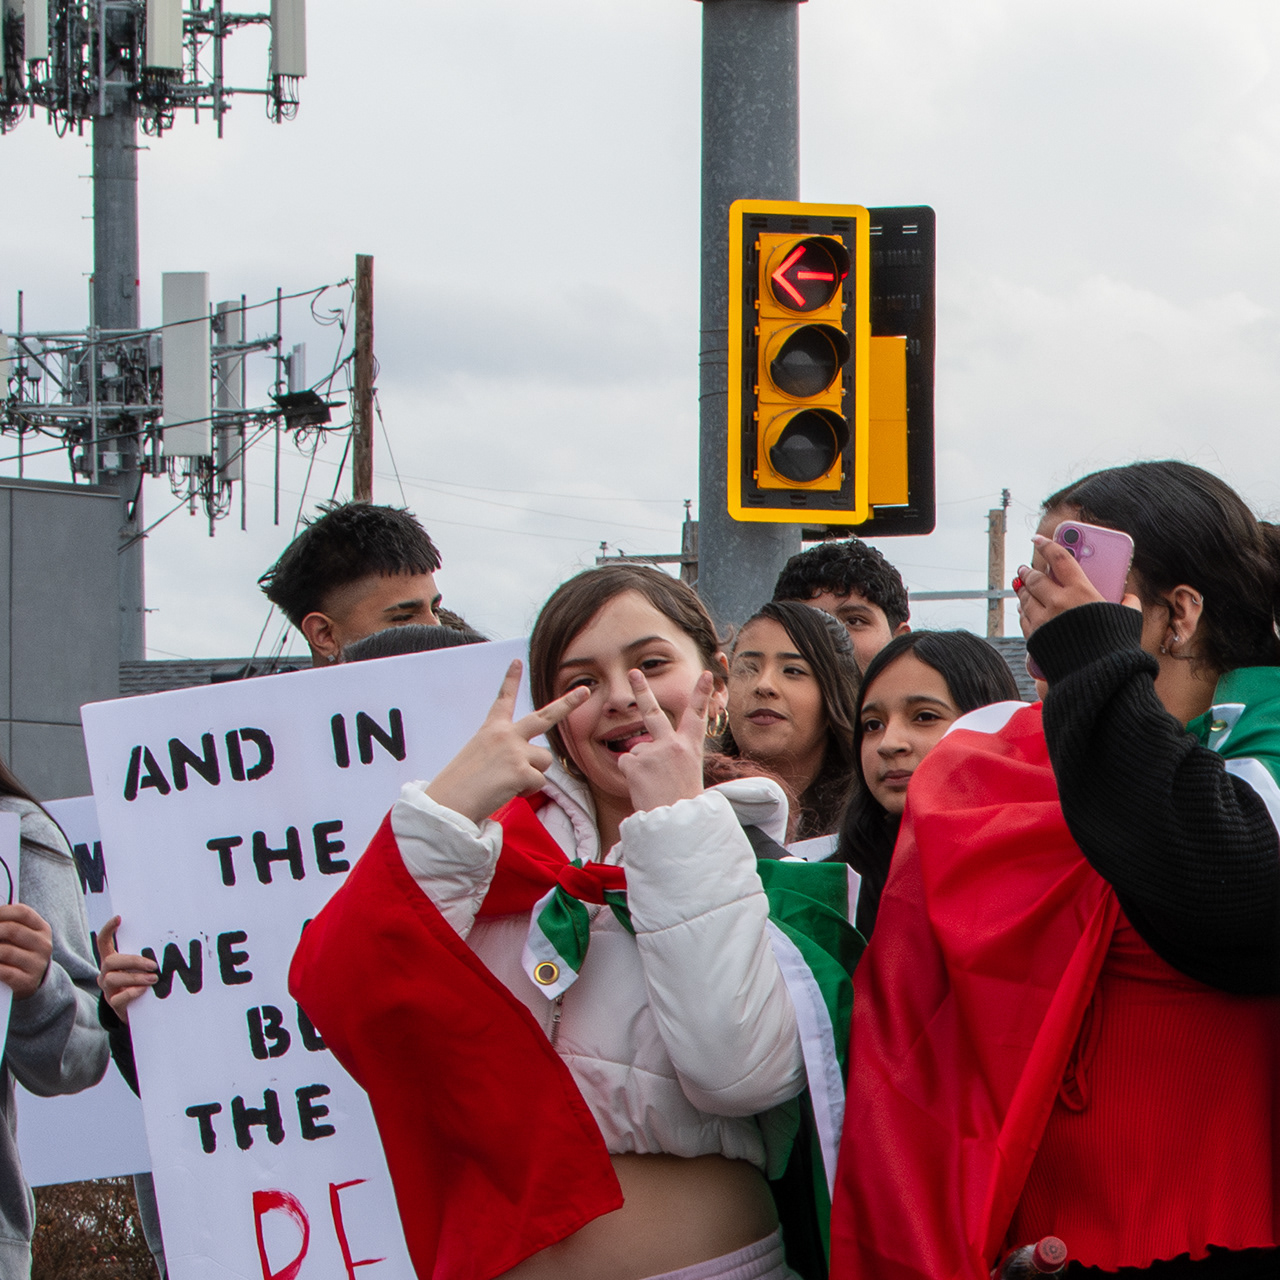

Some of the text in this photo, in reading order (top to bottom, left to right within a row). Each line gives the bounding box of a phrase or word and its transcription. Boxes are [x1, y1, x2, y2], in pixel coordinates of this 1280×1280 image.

[124, 708, 407, 800] AND IN
[207, 820, 350, 886] THE
[142, 930, 253, 1000] WE
[186, 1084, 336, 1154] THE
